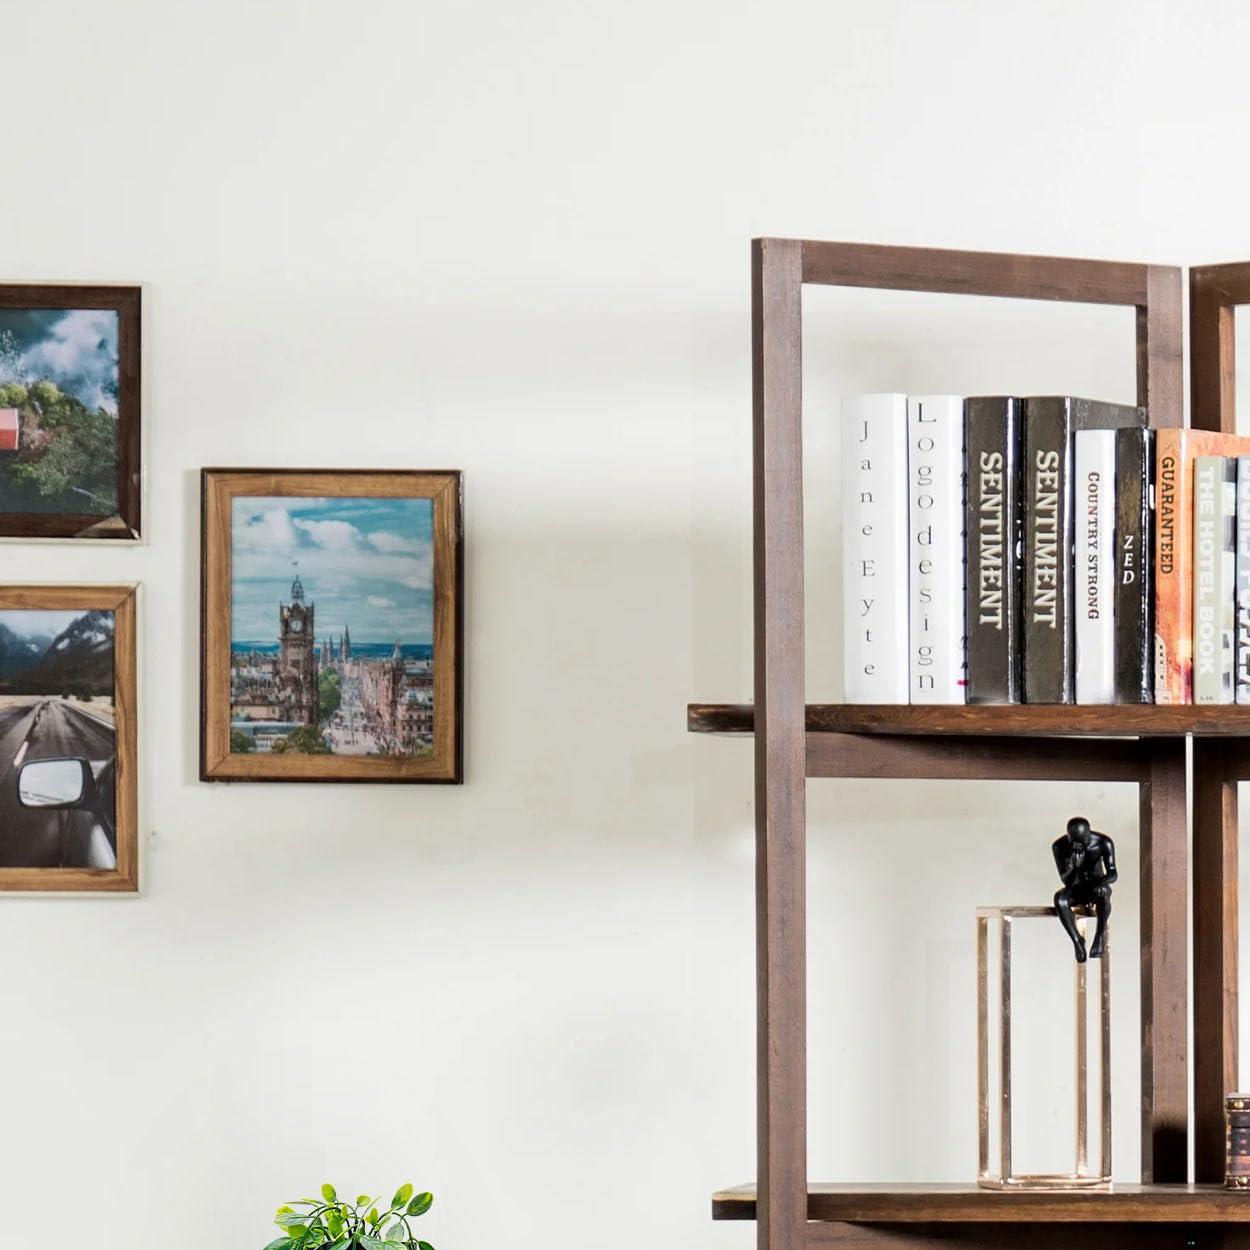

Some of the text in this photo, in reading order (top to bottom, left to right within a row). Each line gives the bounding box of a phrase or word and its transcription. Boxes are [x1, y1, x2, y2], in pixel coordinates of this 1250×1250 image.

[859, 420, 875, 537] Jane
[1160, 456, 1176, 575] GUARANTEED
[1198, 466, 1215, 515] THE
[979, 451, 1003, 630] SENTIMENT
[1033, 450, 1060, 629] SENTIMENT
[1087, 471, 1101, 620] COUNTRY STRONG
[1122, 535, 1136, 585] ZED
[1198, 520, 1215, 600] HOTEL
[1198, 605, 1215, 676] BOOK
